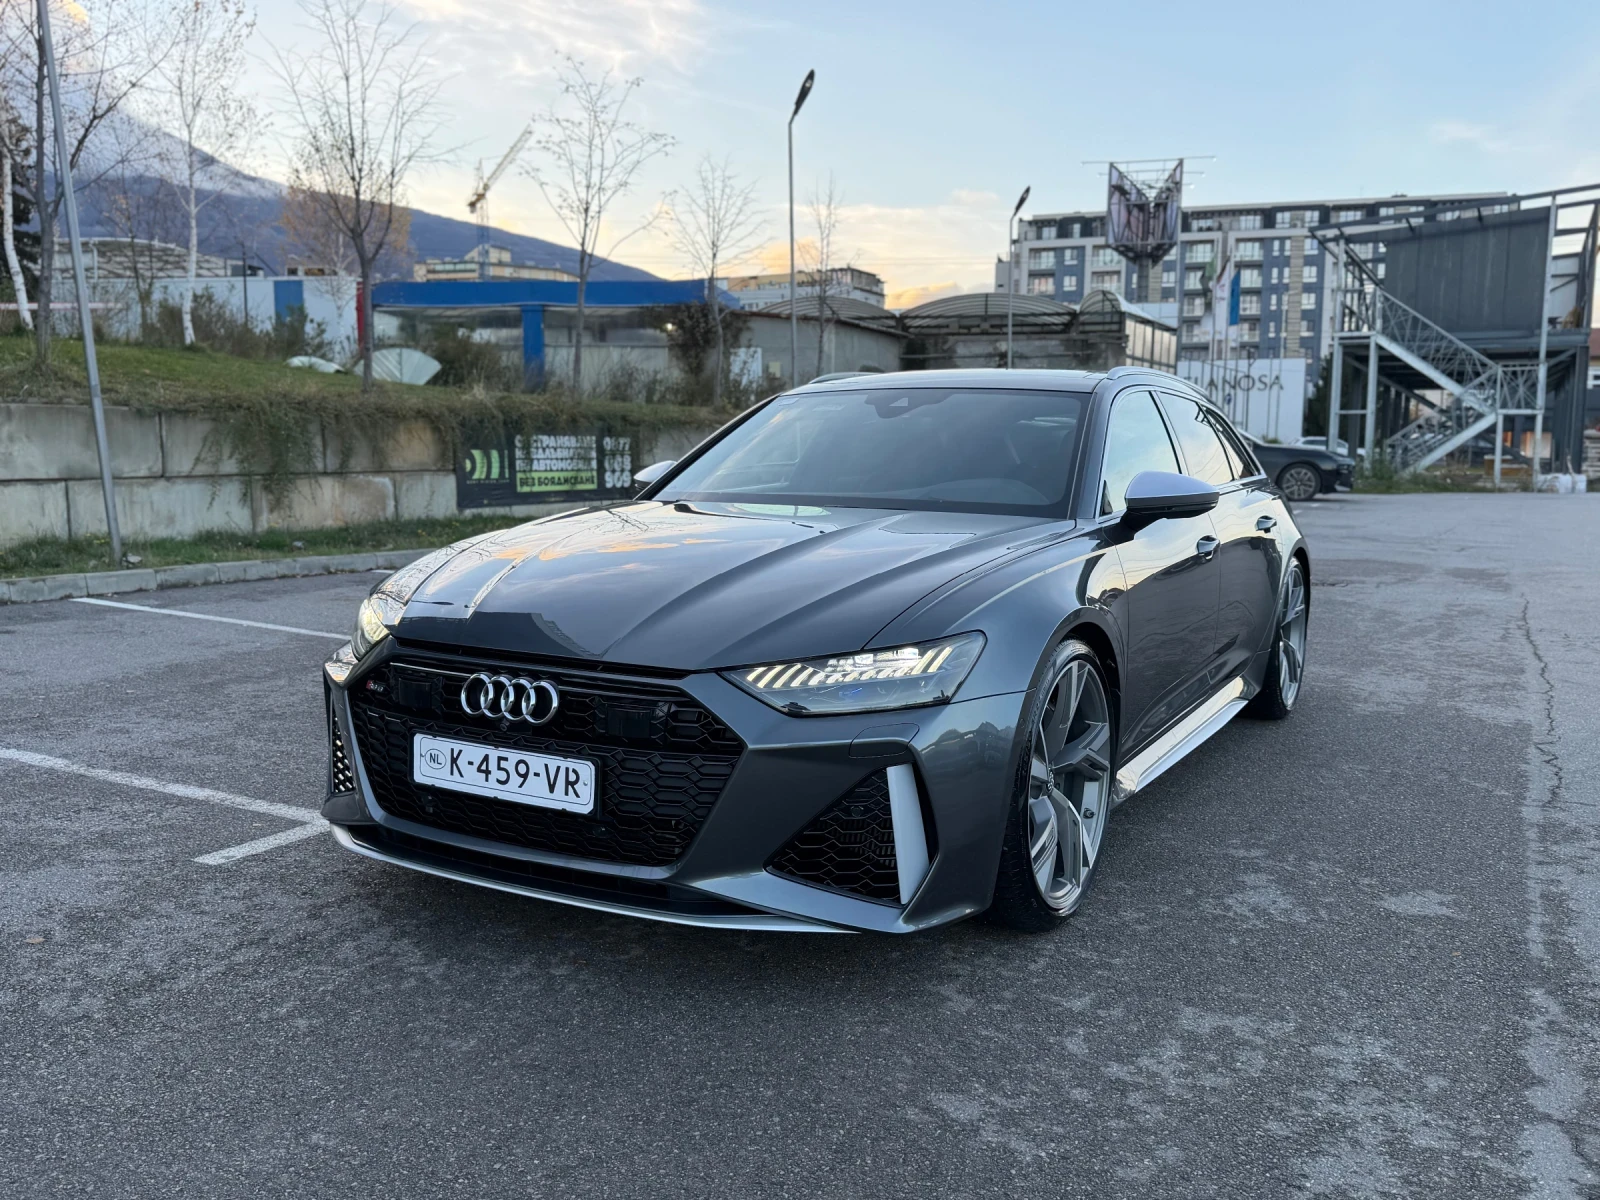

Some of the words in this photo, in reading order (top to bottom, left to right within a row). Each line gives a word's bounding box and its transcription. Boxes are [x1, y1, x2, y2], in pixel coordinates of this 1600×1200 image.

[514, 434, 597, 447] ОСТРАНЯВАНЕ
[519, 477, 536, 487] БЕЗ
[538, 475, 596, 486] БОЯДИСВАНЕ
[429, 753, 443, 766] NL
[450, 747, 581, 798] K-459-VR
